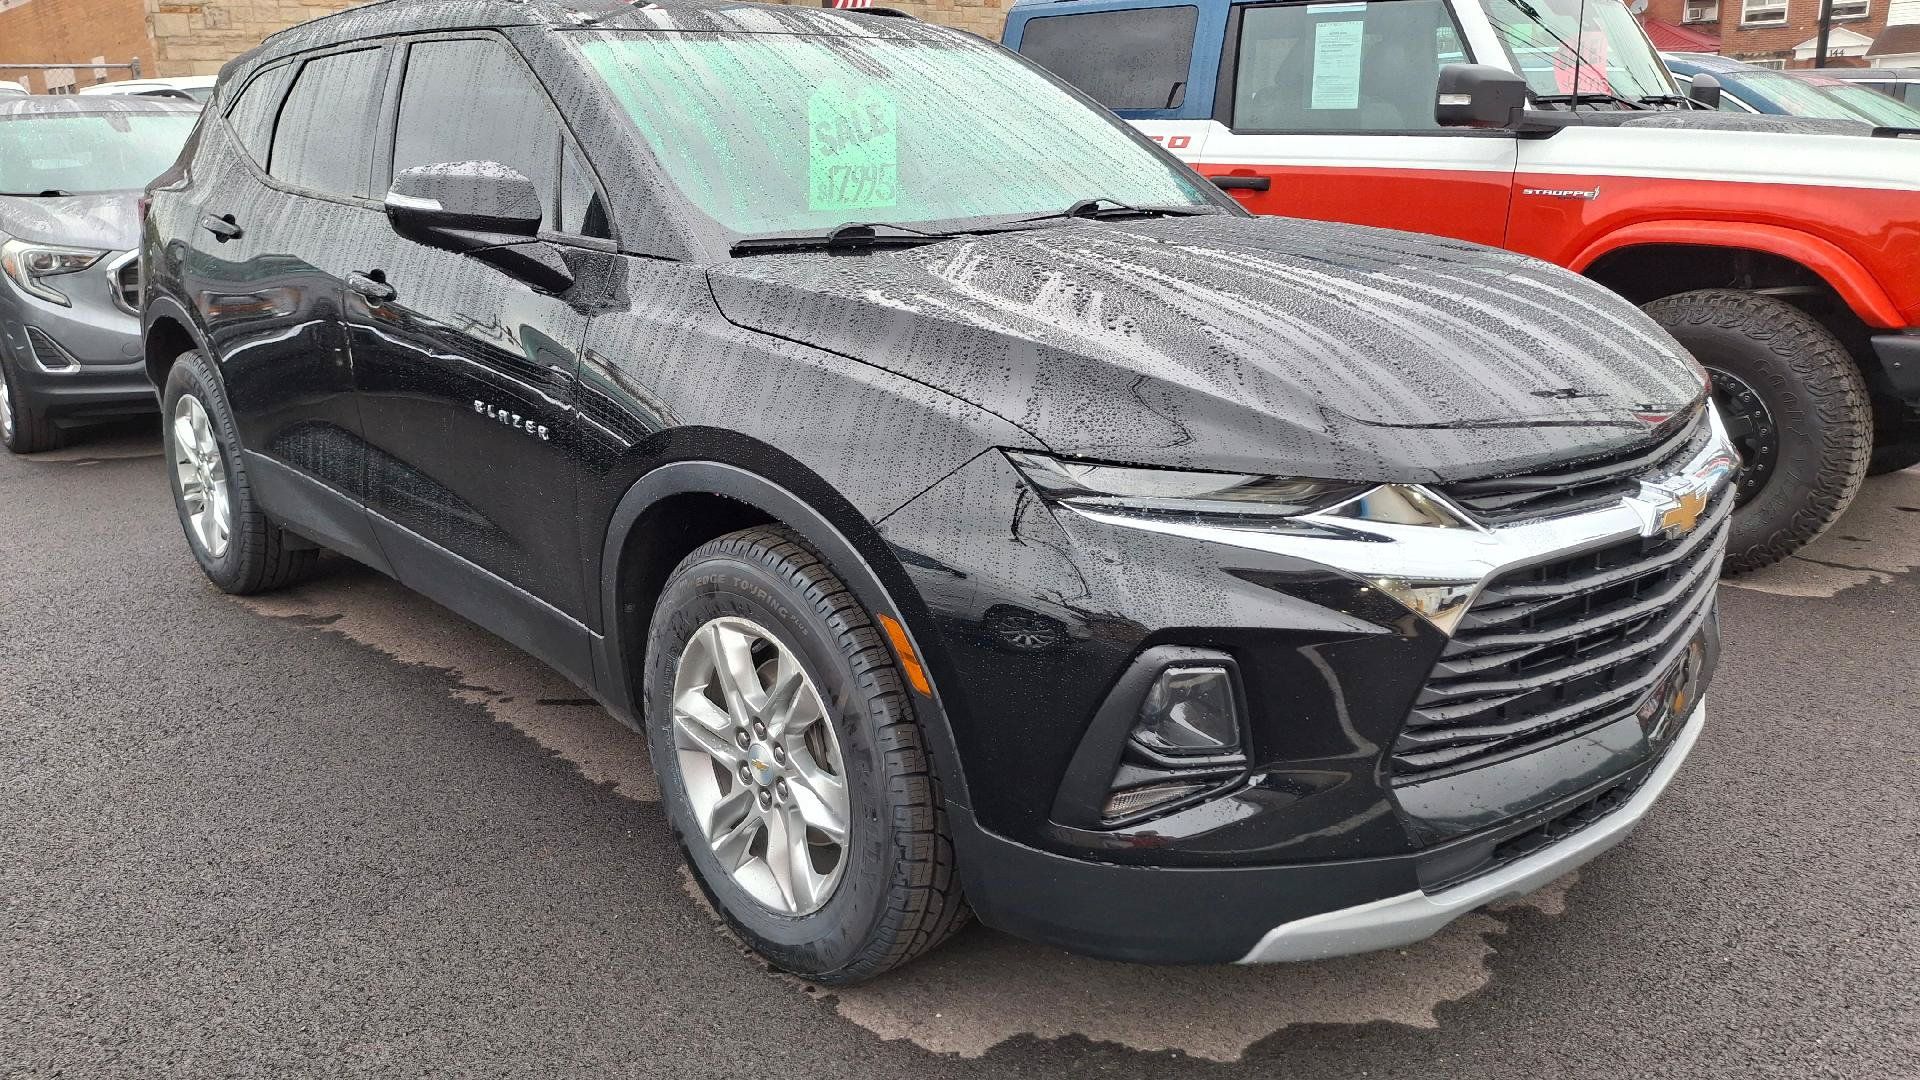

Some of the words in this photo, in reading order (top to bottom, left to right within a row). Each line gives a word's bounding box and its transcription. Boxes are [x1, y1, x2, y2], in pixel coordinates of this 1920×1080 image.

[1830, 49, 1845, 57] 144
[815, 103, 889, 156] SALE
[473, 399, 550, 441] BLAZER
[732, 577, 789, 619] TOURING
